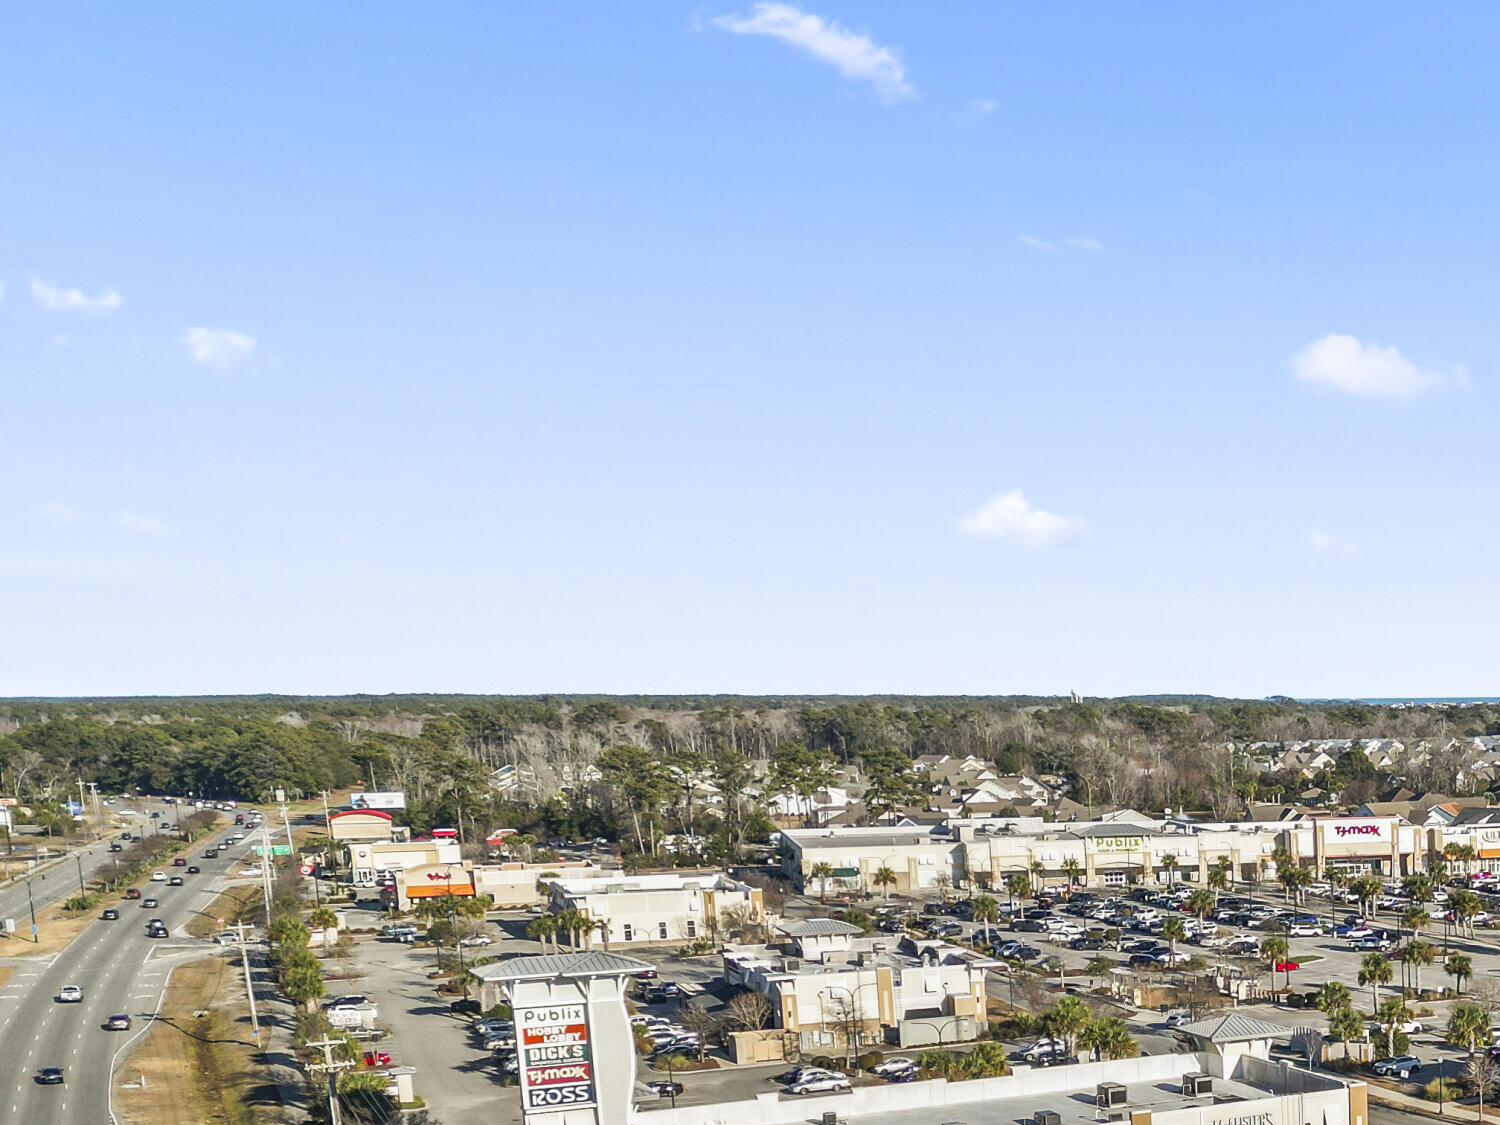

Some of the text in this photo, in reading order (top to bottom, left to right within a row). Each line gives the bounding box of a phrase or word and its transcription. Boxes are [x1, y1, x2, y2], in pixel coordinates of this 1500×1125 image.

[524, 1007, 581, 1023] Publix
[527, 1025, 568, 1037] HOBBY
[543, 1032, 581, 1043] LOBBY
[528, 1045, 584, 1061] DICK'S
[532, 1086, 589, 1105] ROSS
